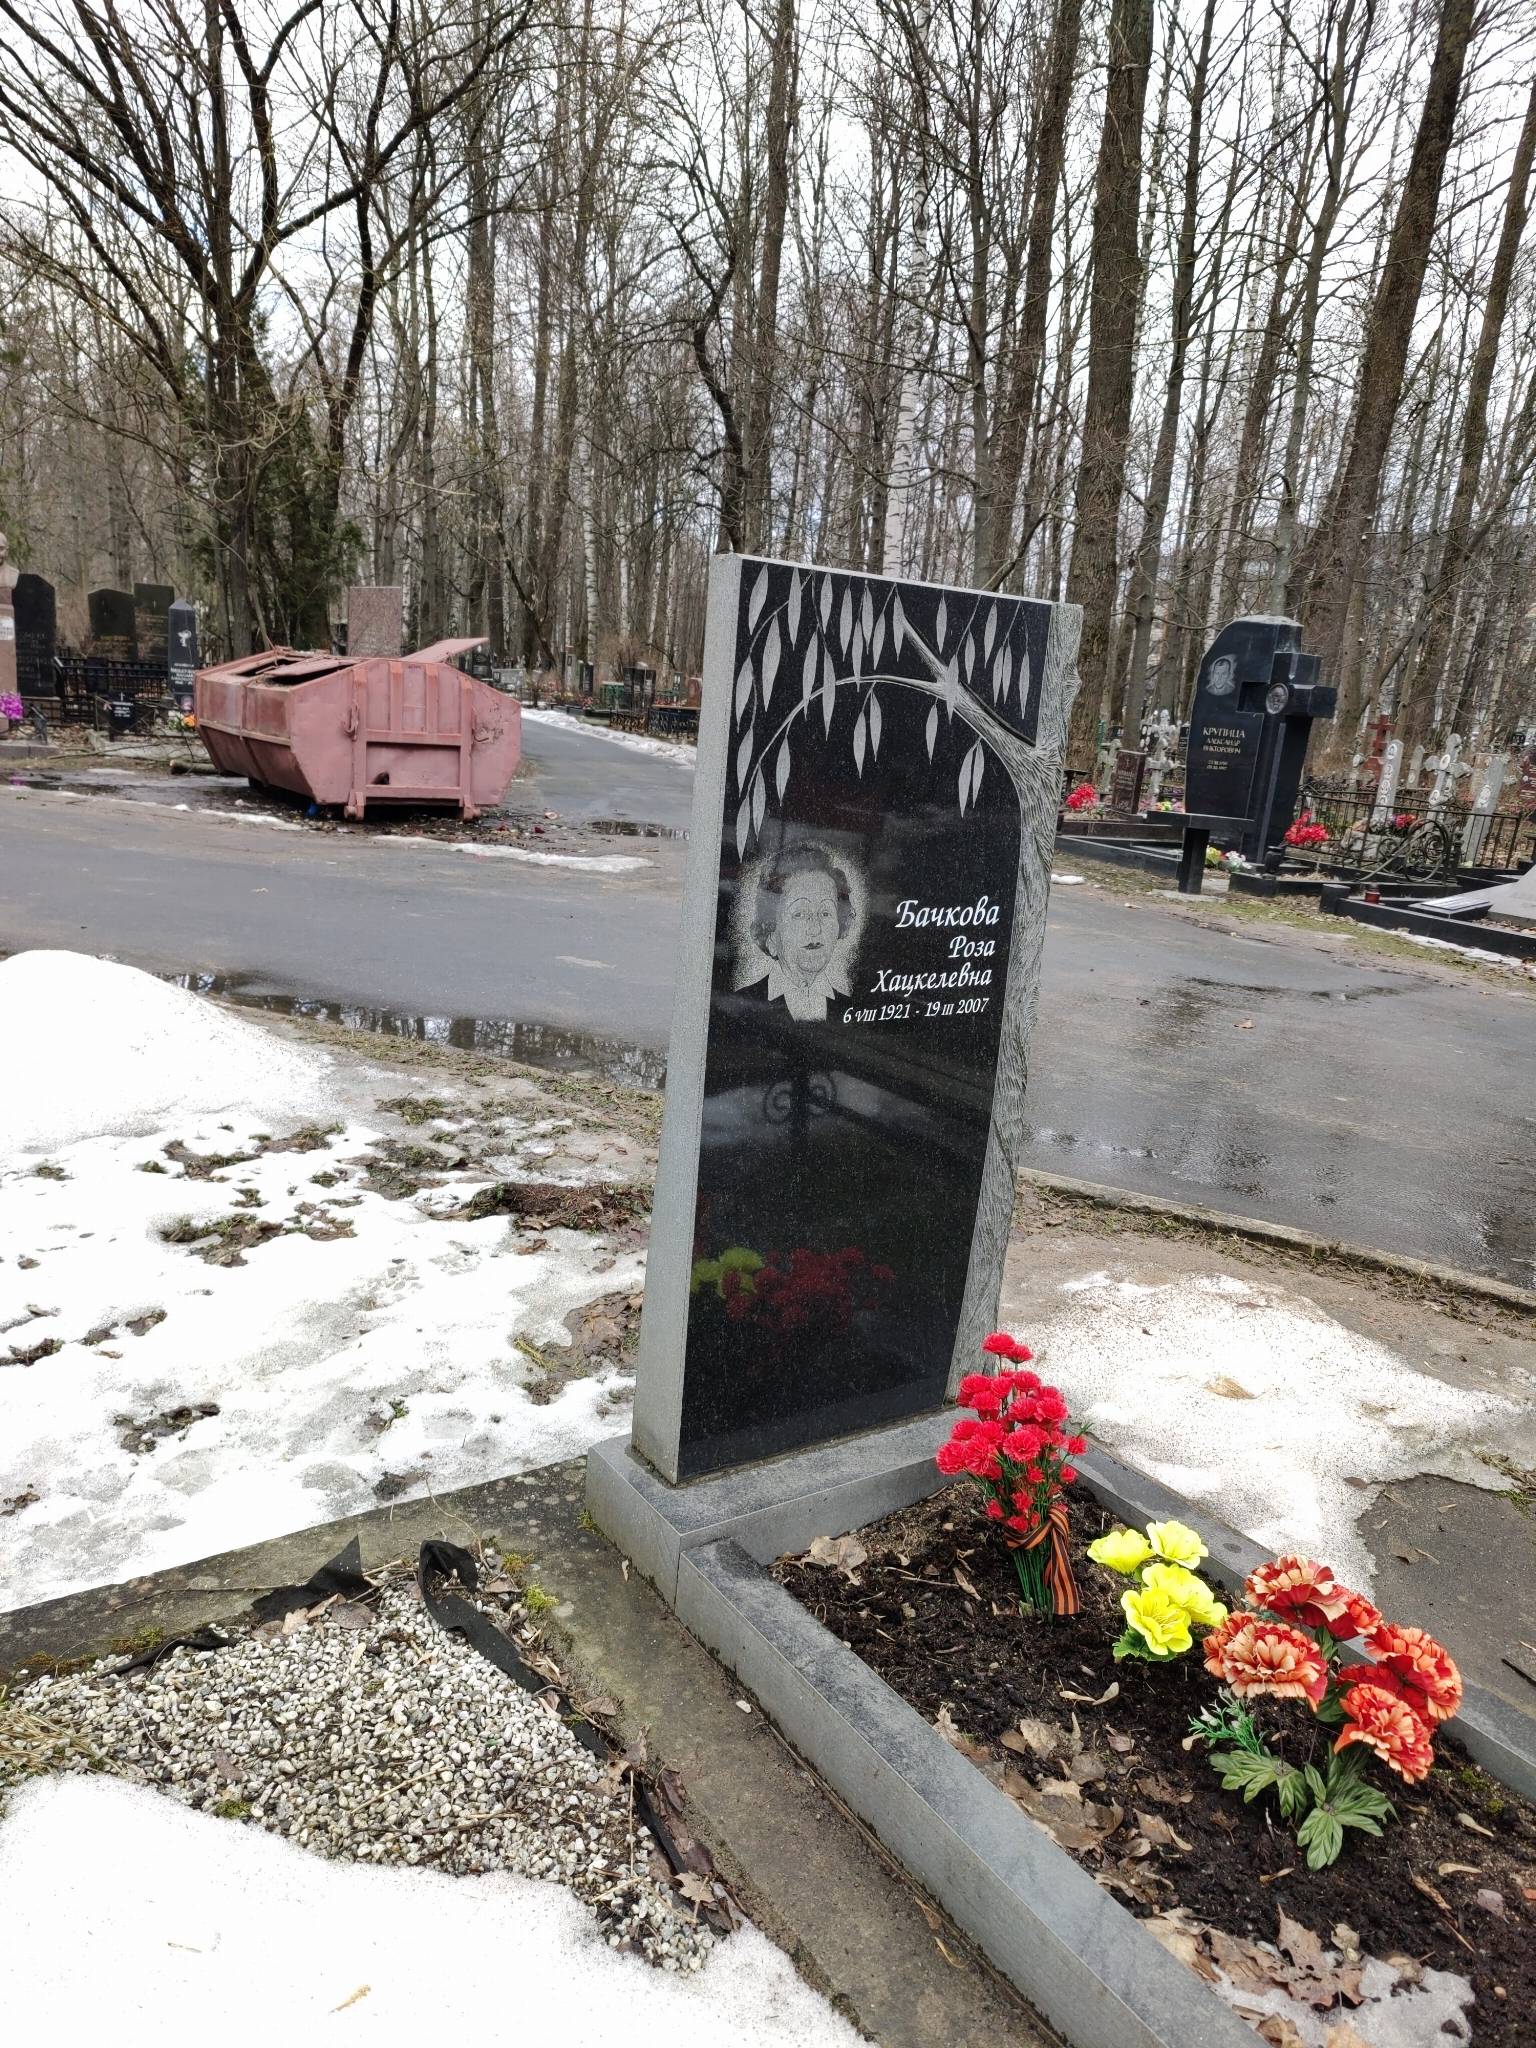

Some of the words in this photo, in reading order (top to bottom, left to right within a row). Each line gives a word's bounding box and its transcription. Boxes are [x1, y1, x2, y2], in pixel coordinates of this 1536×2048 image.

[895, 896, 1000, 928] Бачкова
[948, 935, 996, 958] Роза
[870, 962, 992, 998] Хацкелевна
[843, 1007, 854, 1024] 6
[878, 1003, 911, 1021] 1921
[924, 1001, 941, 1017] 19
[956, 998, 990, 1015] 2007
